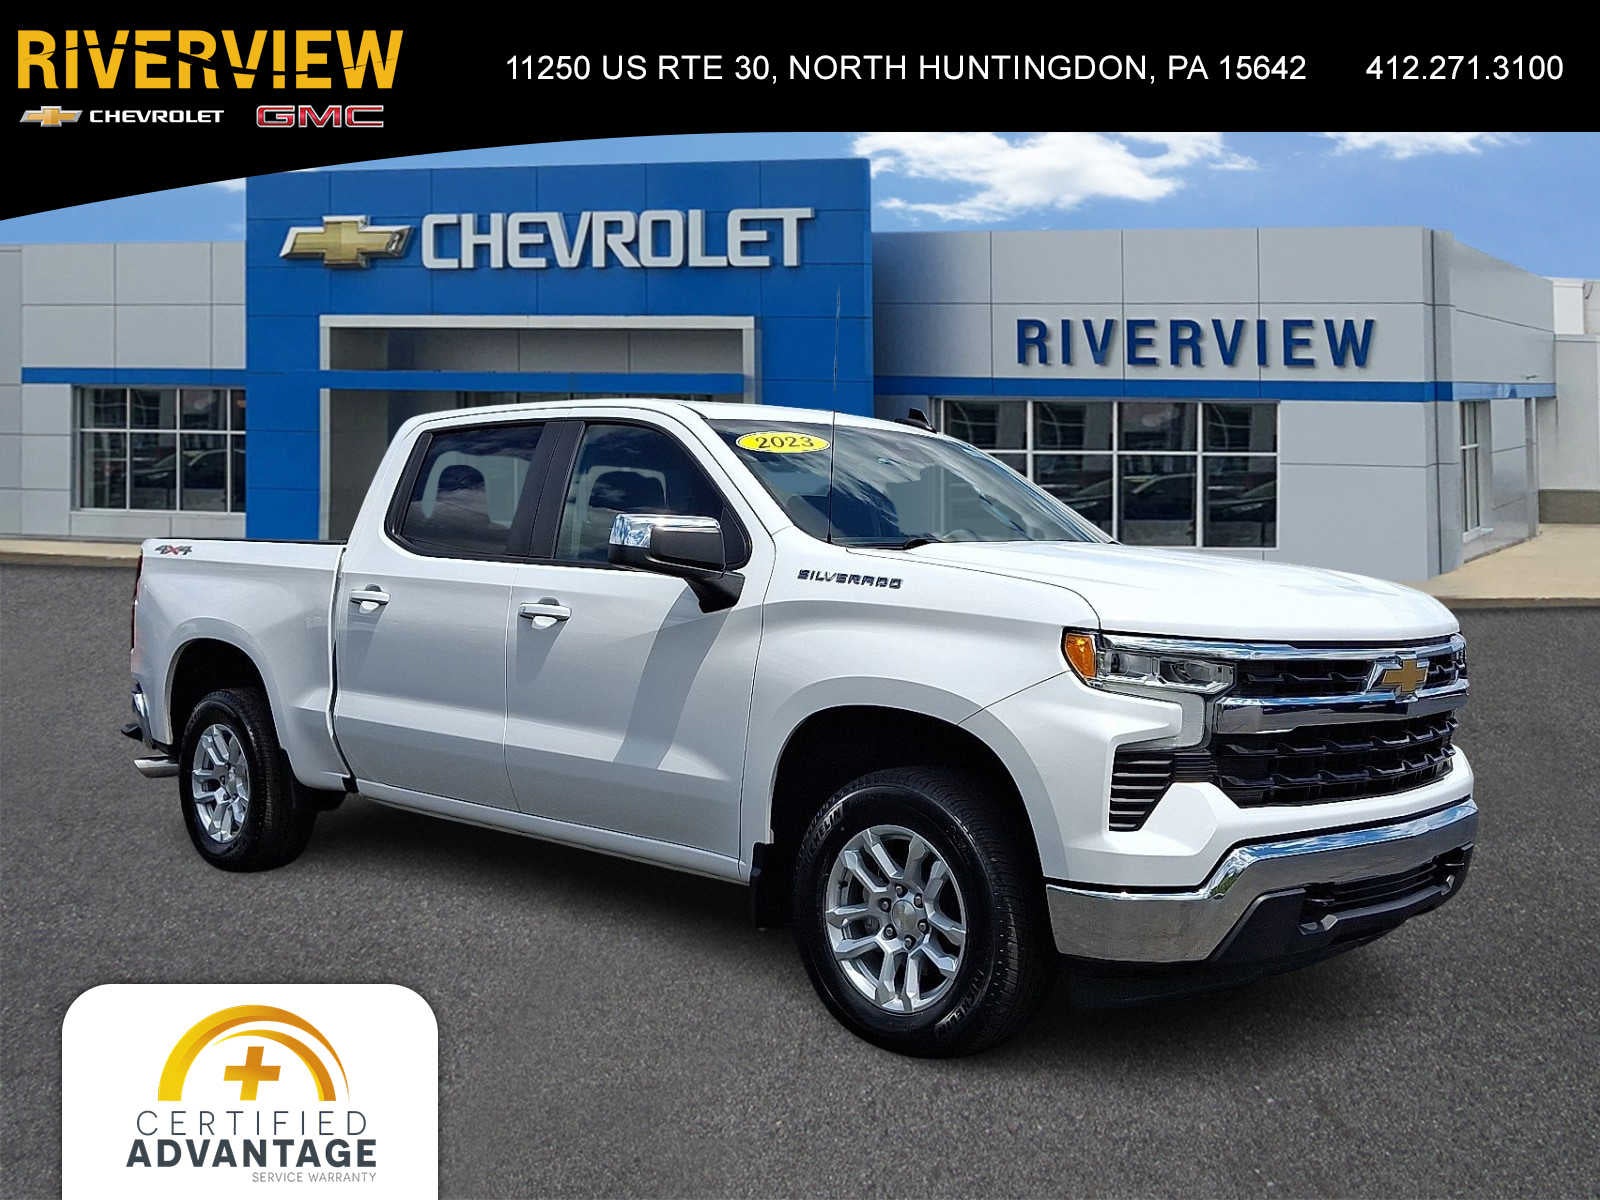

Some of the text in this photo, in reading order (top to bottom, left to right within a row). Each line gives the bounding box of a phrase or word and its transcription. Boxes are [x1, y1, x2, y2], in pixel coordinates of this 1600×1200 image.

[420, 207, 813, 270] CHEVROLET
[1016, 318, 1376, 368] RIVERVIEW
[754, 435, 816, 450] 2023
[797, 568, 903, 590] SILVERADO
